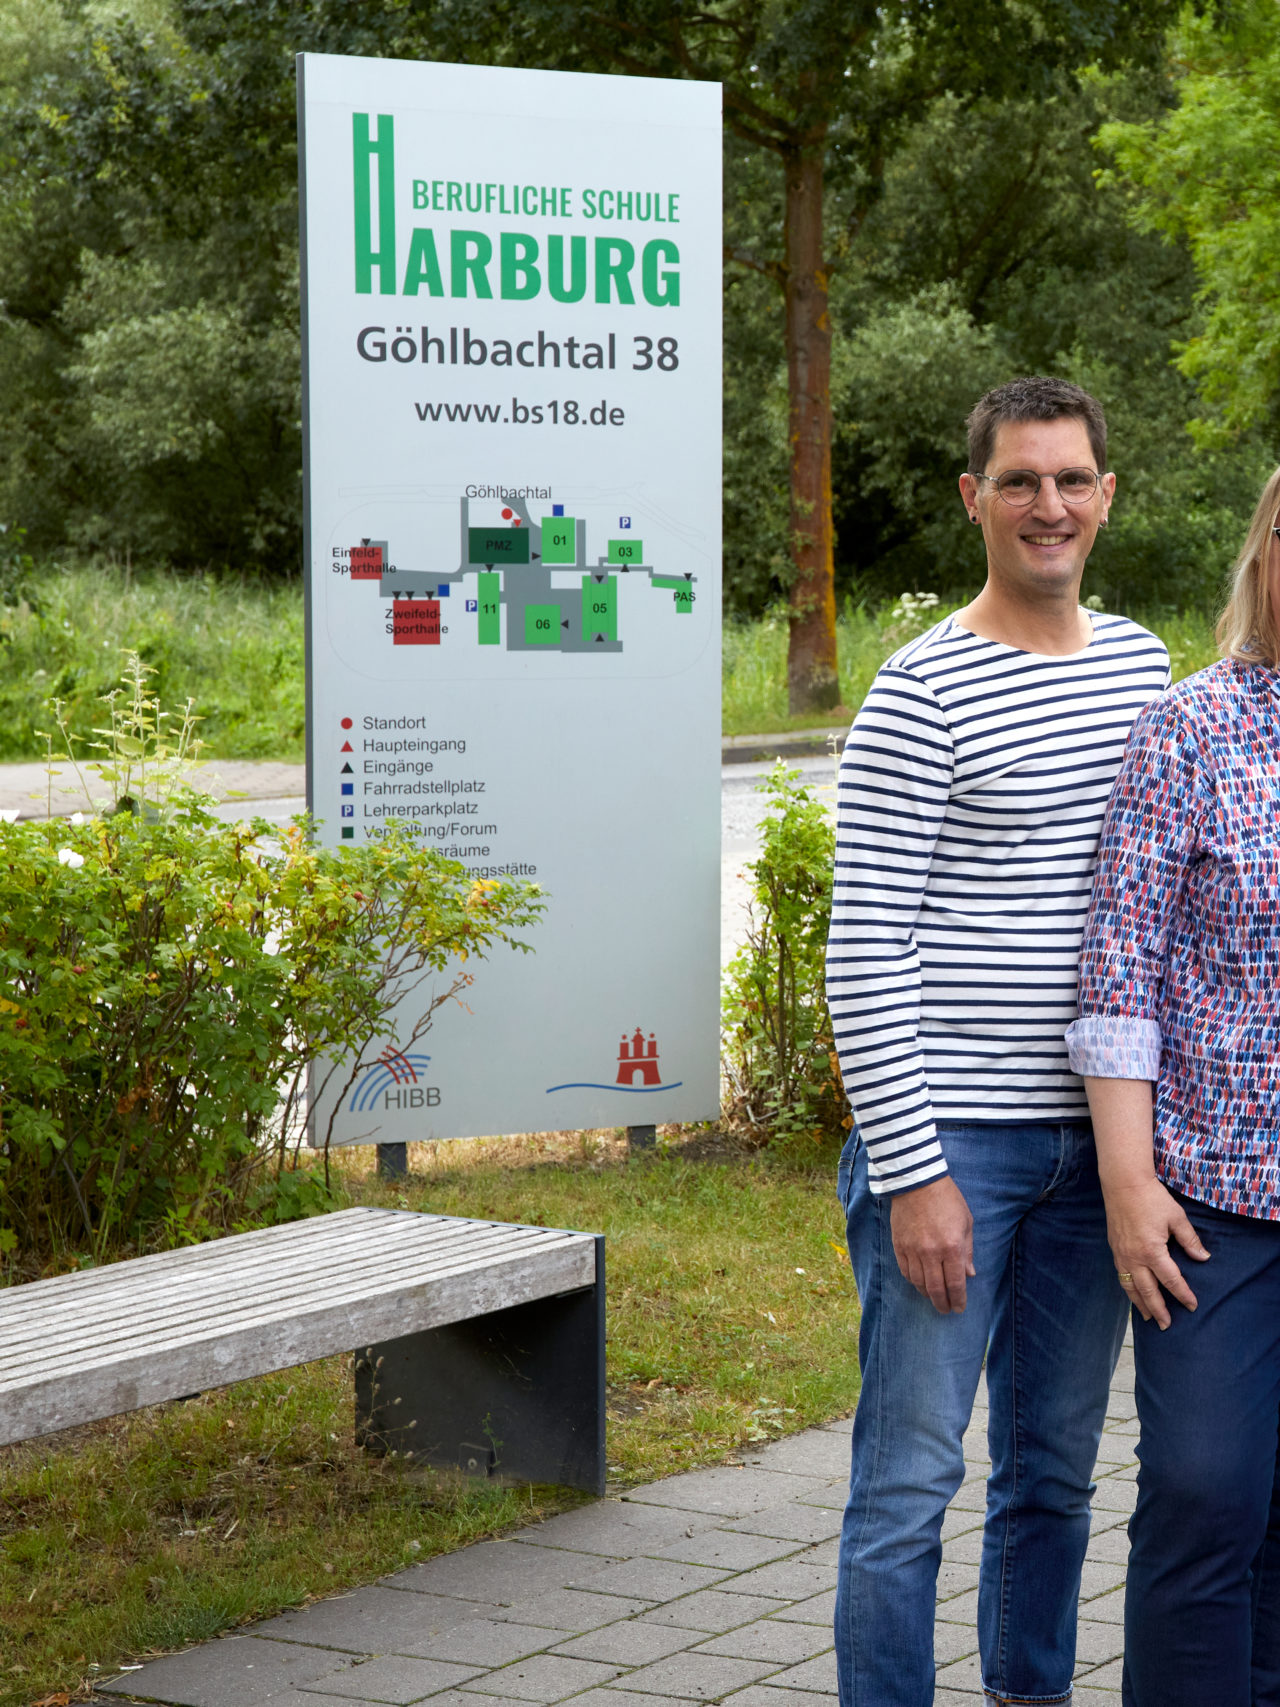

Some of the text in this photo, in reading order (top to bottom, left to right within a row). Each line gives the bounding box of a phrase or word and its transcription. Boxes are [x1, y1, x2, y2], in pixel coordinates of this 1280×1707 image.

[412, 179, 680, 223] BERUFLICHE SCHULE
[352, 112, 681, 307] HARBURG
[356, 326, 680, 371] Göhlbachtal 38
[415, 398, 625, 426] www.bs18.de
[465, 485, 552, 498] Göhlbachtal
[486, 541, 512, 550] PMZ
[553, 535, 566, 544] 01
[332, 547, 379, 558] Einfeld-
[618, 547, 632, 556] 03
[332, 562, 396, 575] Sporthalle
[674, 592, 696, 602] PAS
[483, 604, 496, 613] 11
[593, 603, 607, 612] 05
[386, 609, 441, 620] Zweifeld-
[386, 623, 448, 635] Sporthalle
[536, 619, 550, 629] 06
[363, 717, 426, 729] Standort
[363, 738, 466, 754] Haupteingang
[363, 760, 433, 775] Eingänge
[363, 780, 486, 795] Fahrradstellplatz
[363, 802, 478, 818] Lehrerparkplatz
[385, 1087, 441, 1109] HIBB
